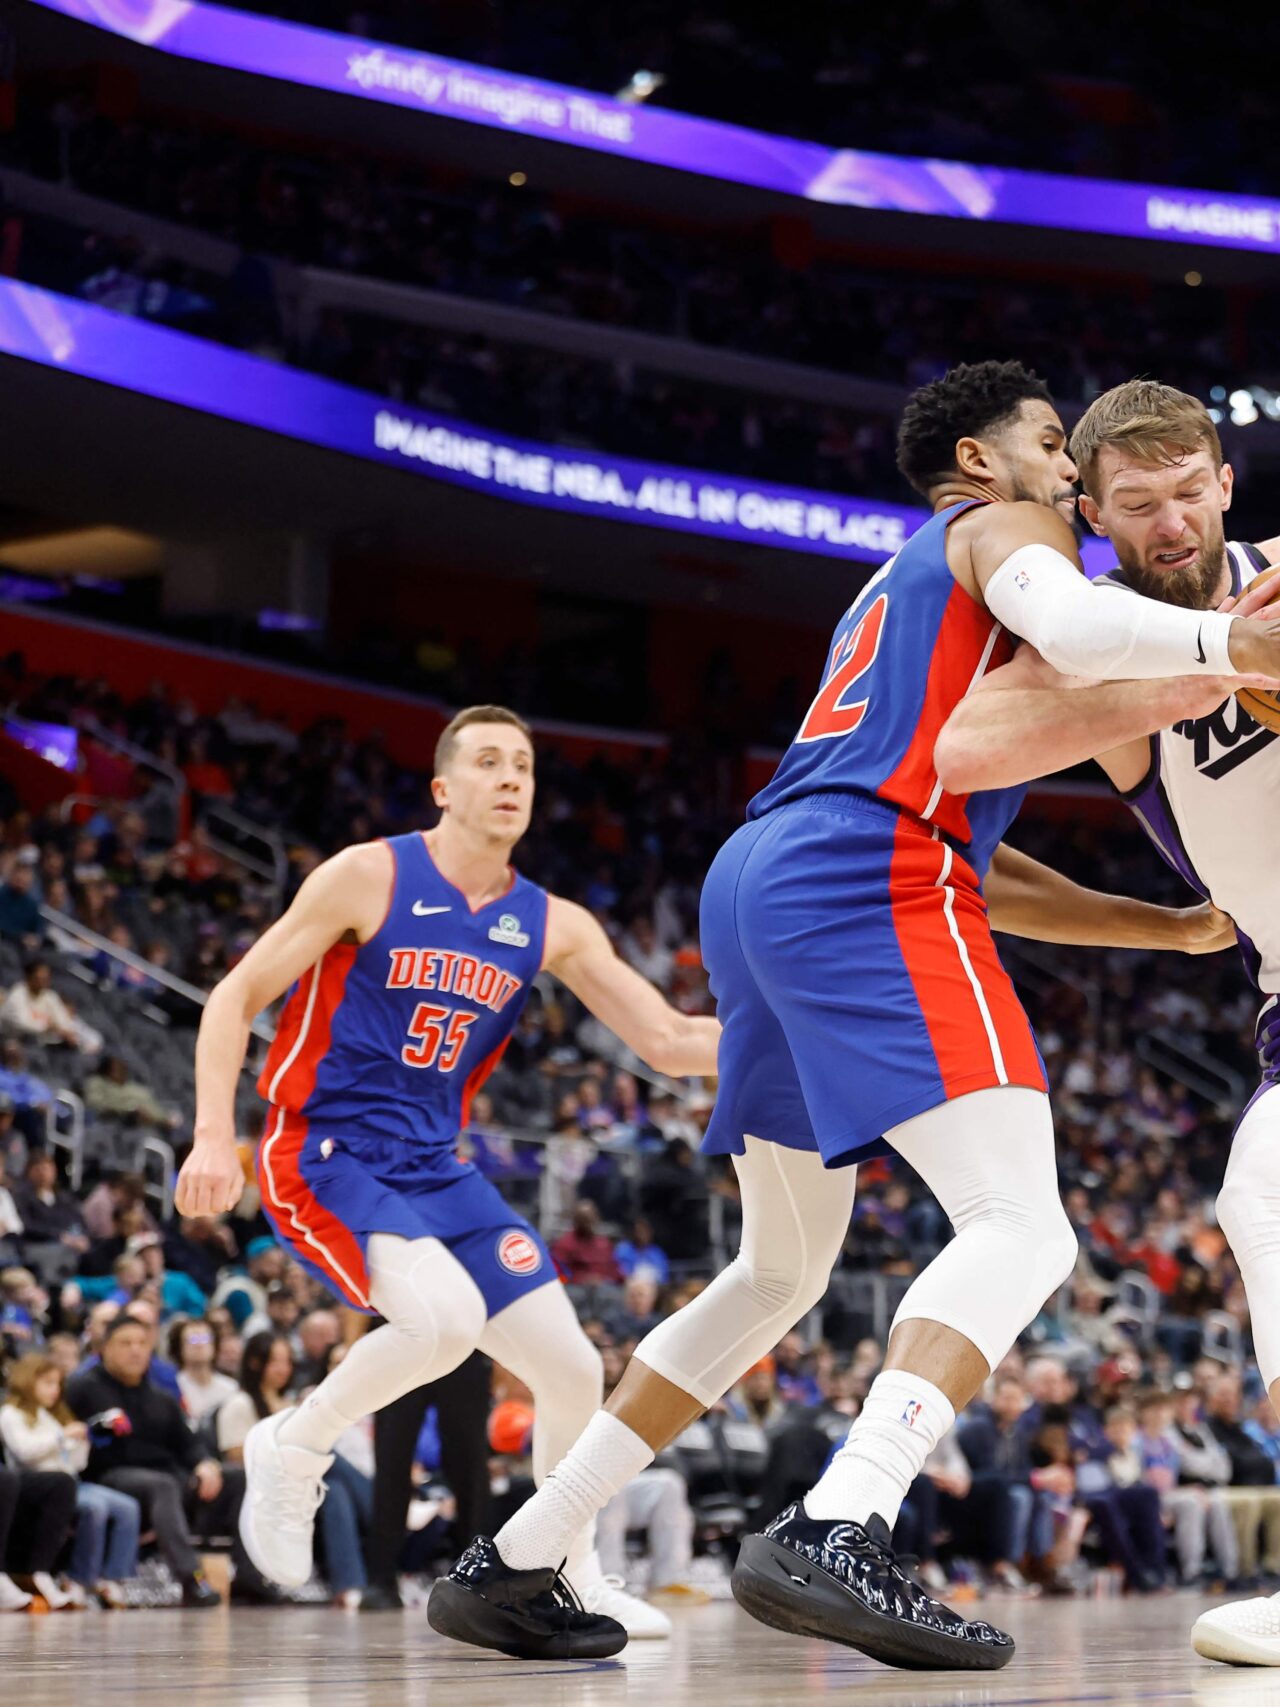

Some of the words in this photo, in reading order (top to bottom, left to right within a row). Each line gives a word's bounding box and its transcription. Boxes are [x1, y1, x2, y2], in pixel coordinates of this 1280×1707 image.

[447, 70, 566, 127] Imagine
[567, 96, 633, 143] That
[1146, 196, 1273, 243] IMAGINE
[374, 409, 494, 480] IMAGINE
[494, 444, 553, 495] THE
[553, 460, 635, 509] NBA.
[635, 476, 698, 520] ALL
[697, 483, 738, 525] IN
[737, 492, 808, 538] ONE
[386, 947, 523, 1013] DETROIT
[401, 1002, 480, 1072] 55
